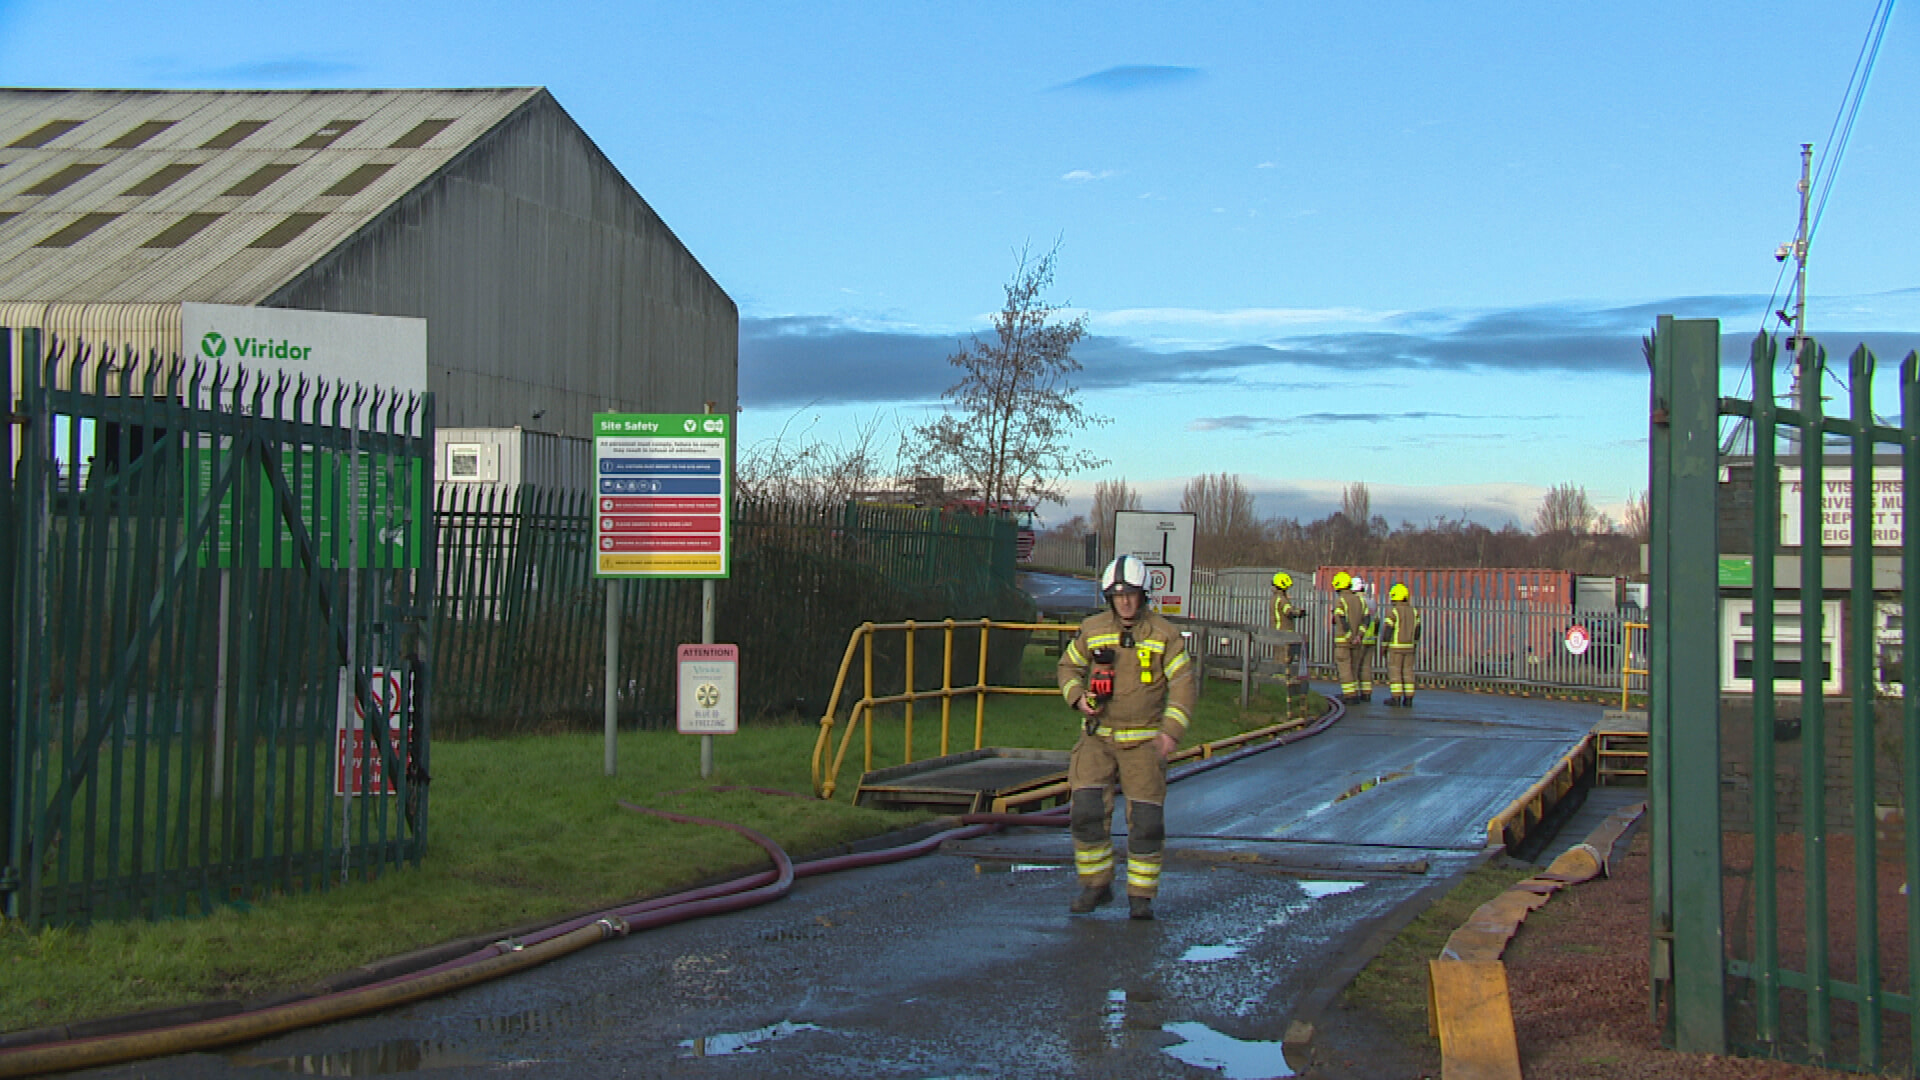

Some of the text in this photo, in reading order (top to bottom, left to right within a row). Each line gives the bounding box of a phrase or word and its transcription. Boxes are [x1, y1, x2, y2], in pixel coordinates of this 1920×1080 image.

[233, 337, 312, 361] Viridor
[600, 421, 659, 433] Site Safety
[683, 648, 734, 657] ATTENTION!
